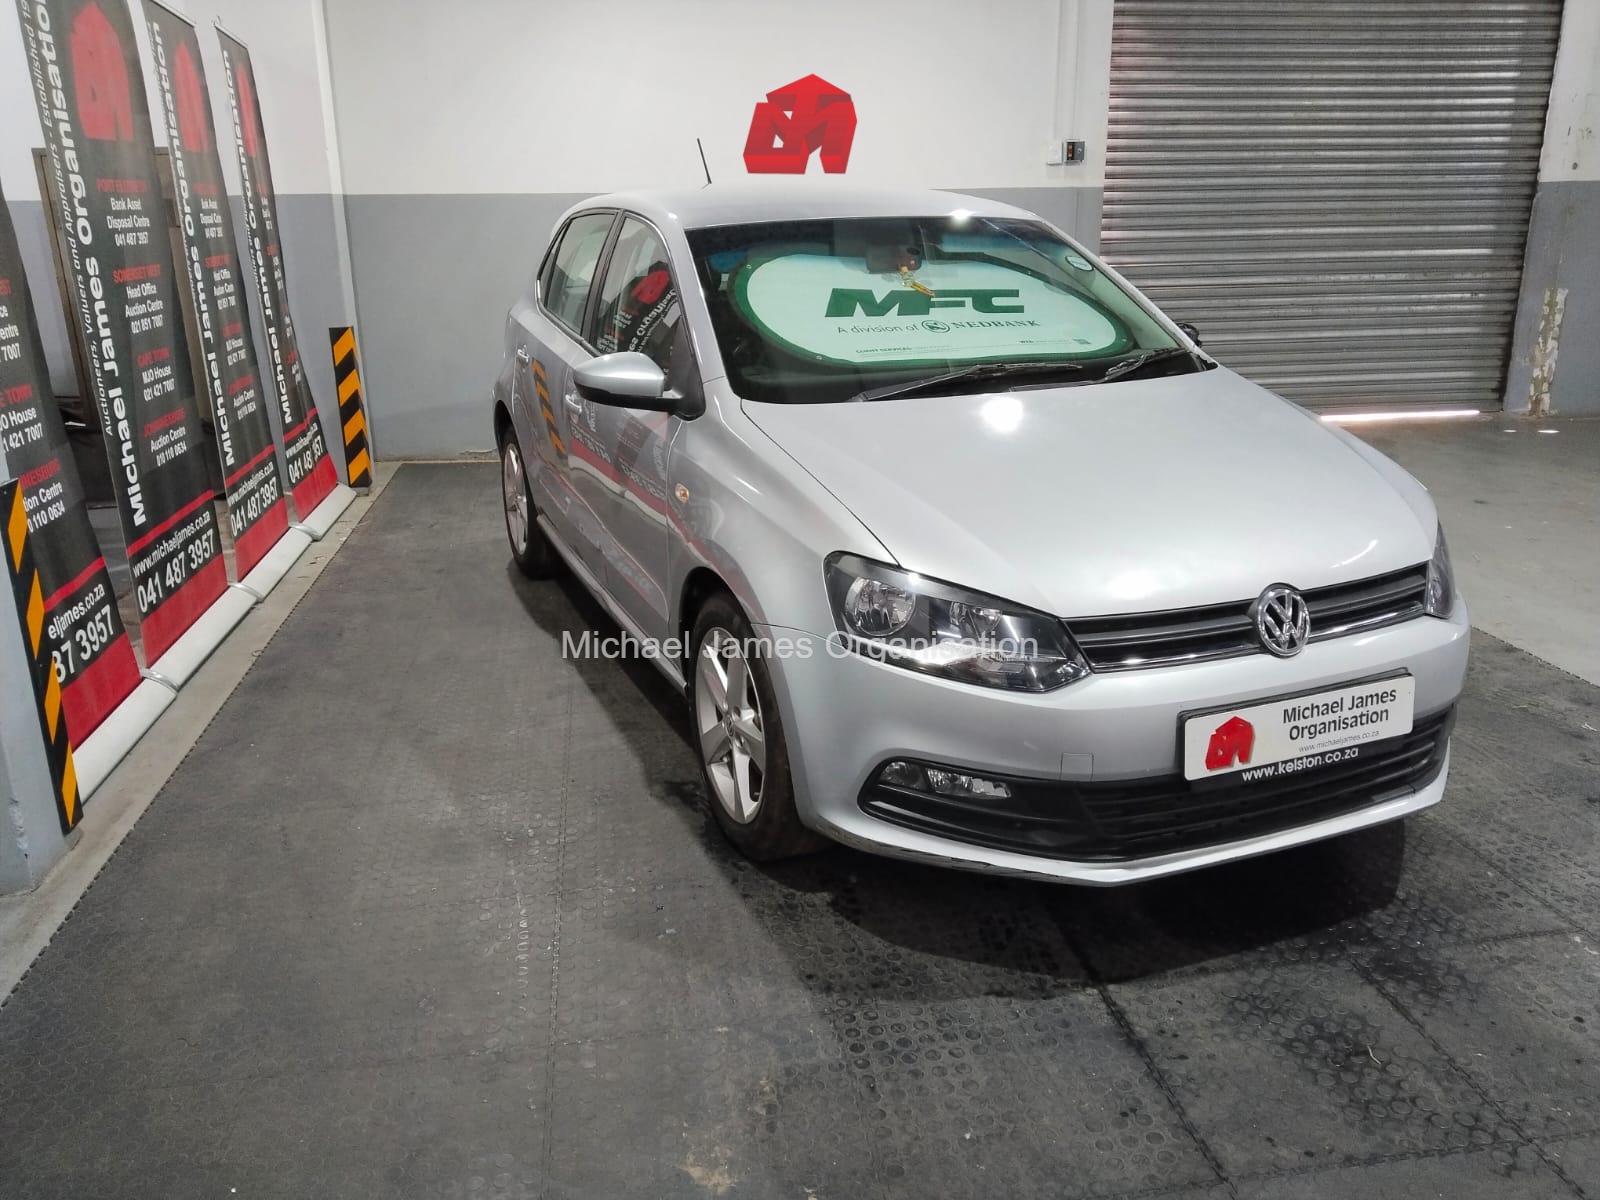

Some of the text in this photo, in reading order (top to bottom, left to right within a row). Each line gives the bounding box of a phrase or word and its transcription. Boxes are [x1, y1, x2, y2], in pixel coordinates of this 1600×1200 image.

[24, 23, 52, 128] Established
[152, 21, 194, 237] Organisation
[50, 143, 75, 234] Appraisers
[67, 236, 81, 270] and
[77, 274, 94, 334] Valuers
[125, 299, 163, 318] Auction Centre
[126, 285, 140, 299] Head
[190, 246, 214, 344] James
[824, 287, 1025, 318] MFC
[86, 256, 119, 377] James
[837, 319, 1041, 335] A division of NEDBANK
[3, 343, 21, 361] 7007
[154, 365, 171, 380] House
[268, 326, 292, 424] Michael
[9, 407, 37, 427] House
[207, 352, 235, 467] Michael
[12, 431, 26, 449] 421
[25, 423, 43, 441] 7007
[150, 426, 186, 453] Auction Centre
[108, 386, 148, 527] Michael
[288, 457, 304, 484] 041
[39, 482, 63, 503] Centre
[230, 476, 278, 537] 041 487 3957
[33, 510, 48, 529] 110
[48, 500, 66, 521] 0634
[133, 510, 211, 578] www.michaeljames.co.za
[137, 528, 215, 613] 041 487 3957
[48, 584, 106, 640] eljames.co.za
[75, 603, 114, 660] 3957
[1283, 688, 1397, 724] Michael James
[1289, 707, 1390, 740] Organisation
[1242, 745, 1359, 782] www.kelston.co.za
